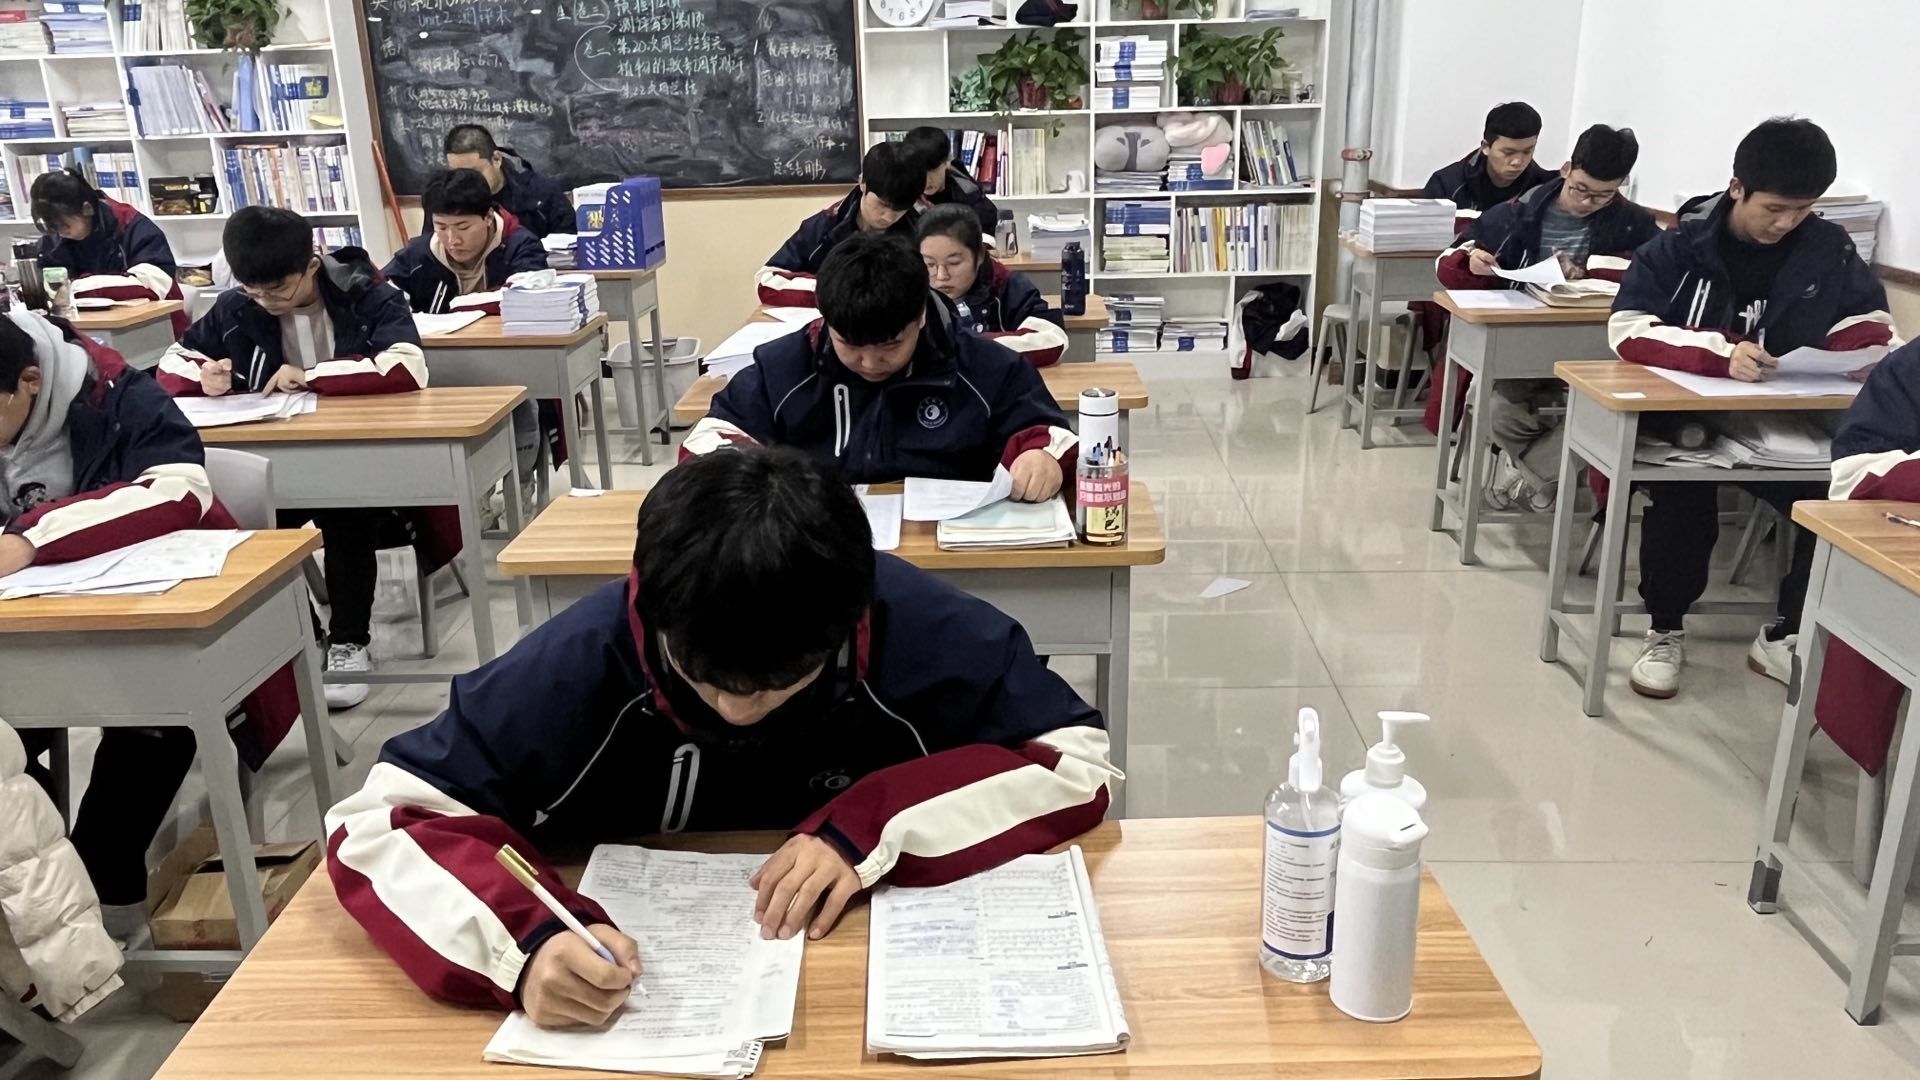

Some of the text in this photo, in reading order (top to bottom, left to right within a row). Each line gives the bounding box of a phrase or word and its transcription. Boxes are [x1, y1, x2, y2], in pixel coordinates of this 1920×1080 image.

[887, 8, 894, 17] 7
[898, 11, 905, 21] 6
[909, 8, 916, 18] 5
[418, 14, 442, 27] Unit
[443, 11, 452, 24] 2
